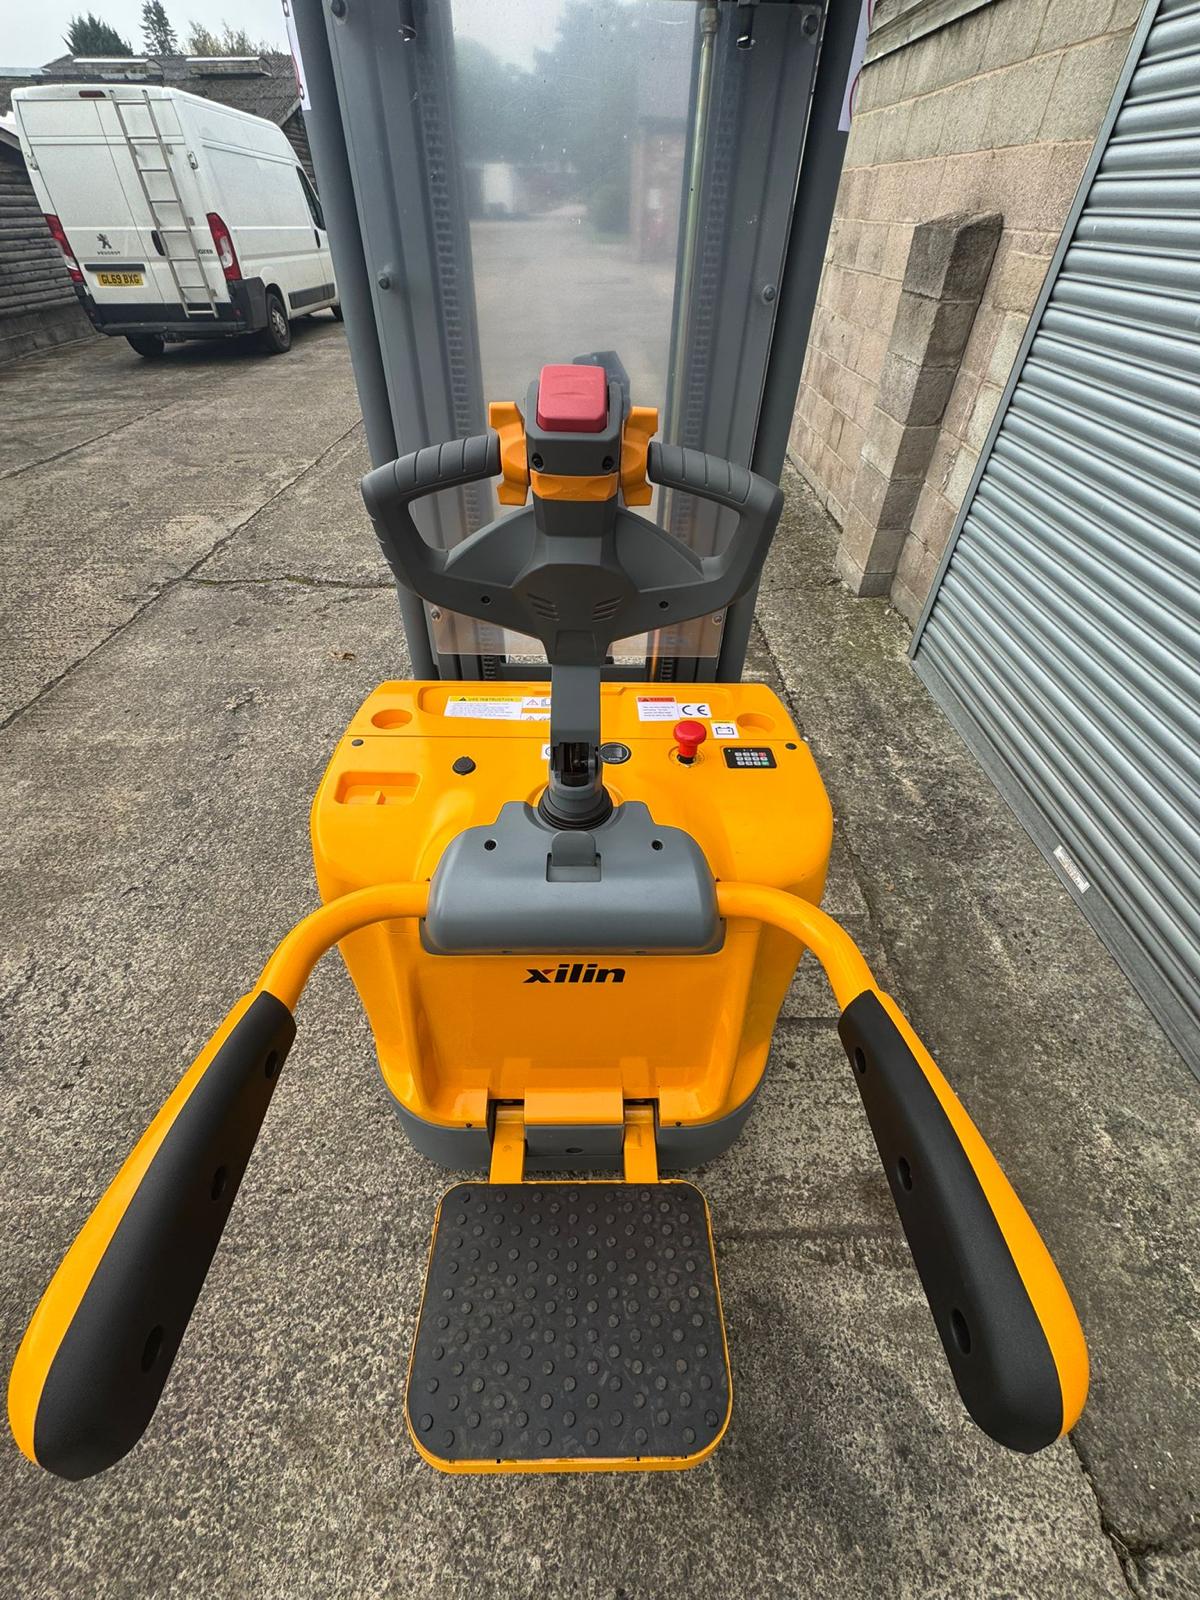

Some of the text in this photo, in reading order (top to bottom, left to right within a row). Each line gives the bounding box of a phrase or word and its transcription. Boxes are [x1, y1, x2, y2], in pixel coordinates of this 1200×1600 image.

[101, 274, 140, 284] GL69 BXG
[522, 963, 626, 983] xilin
